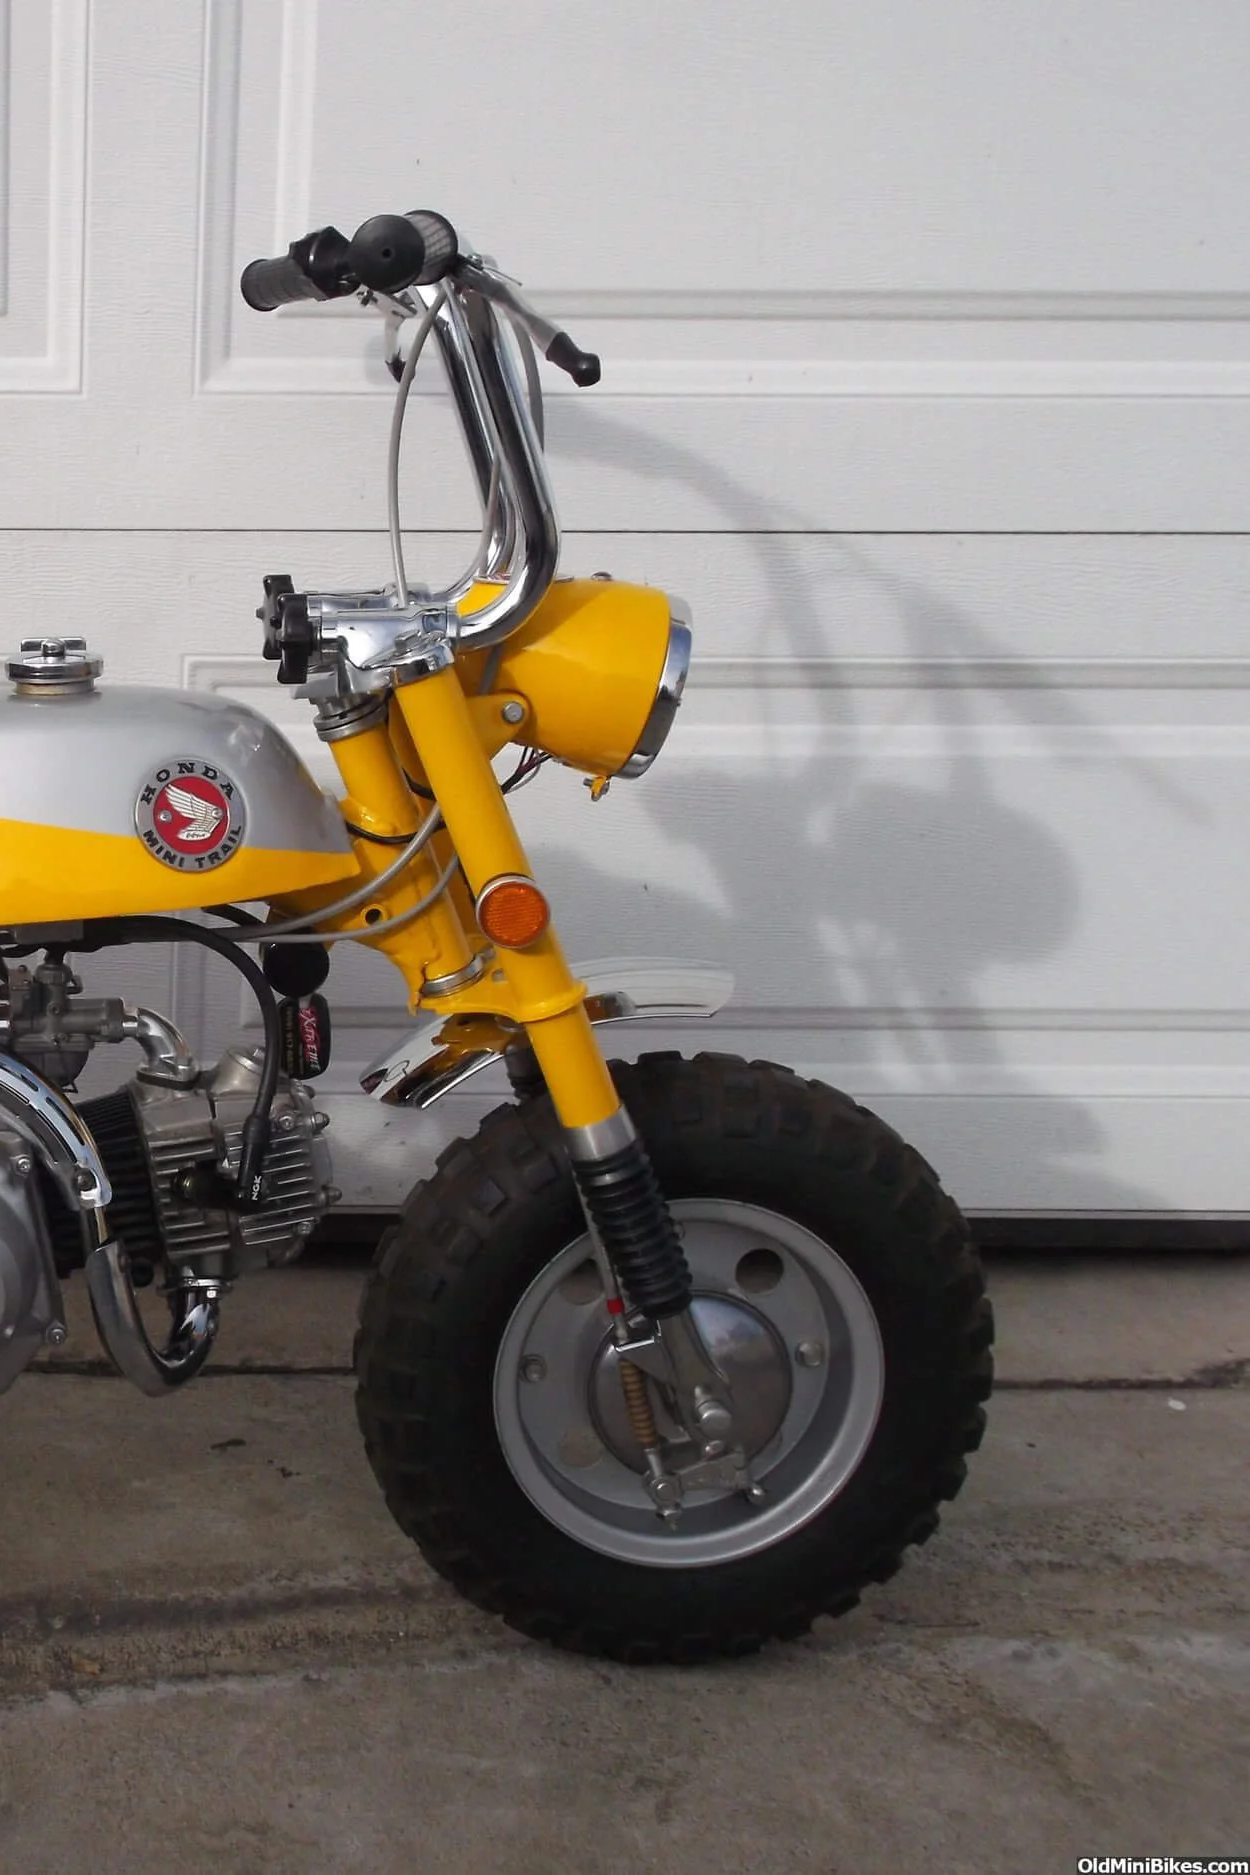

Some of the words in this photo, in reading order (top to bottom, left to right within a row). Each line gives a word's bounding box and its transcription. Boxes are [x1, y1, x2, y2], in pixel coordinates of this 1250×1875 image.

[141, 763, 235, 805] HONDA
[143, 830, 185, 867] MINI
[195, 826, 241, 868] TRAIL
[251, 1175, 263, 1201] NGK
